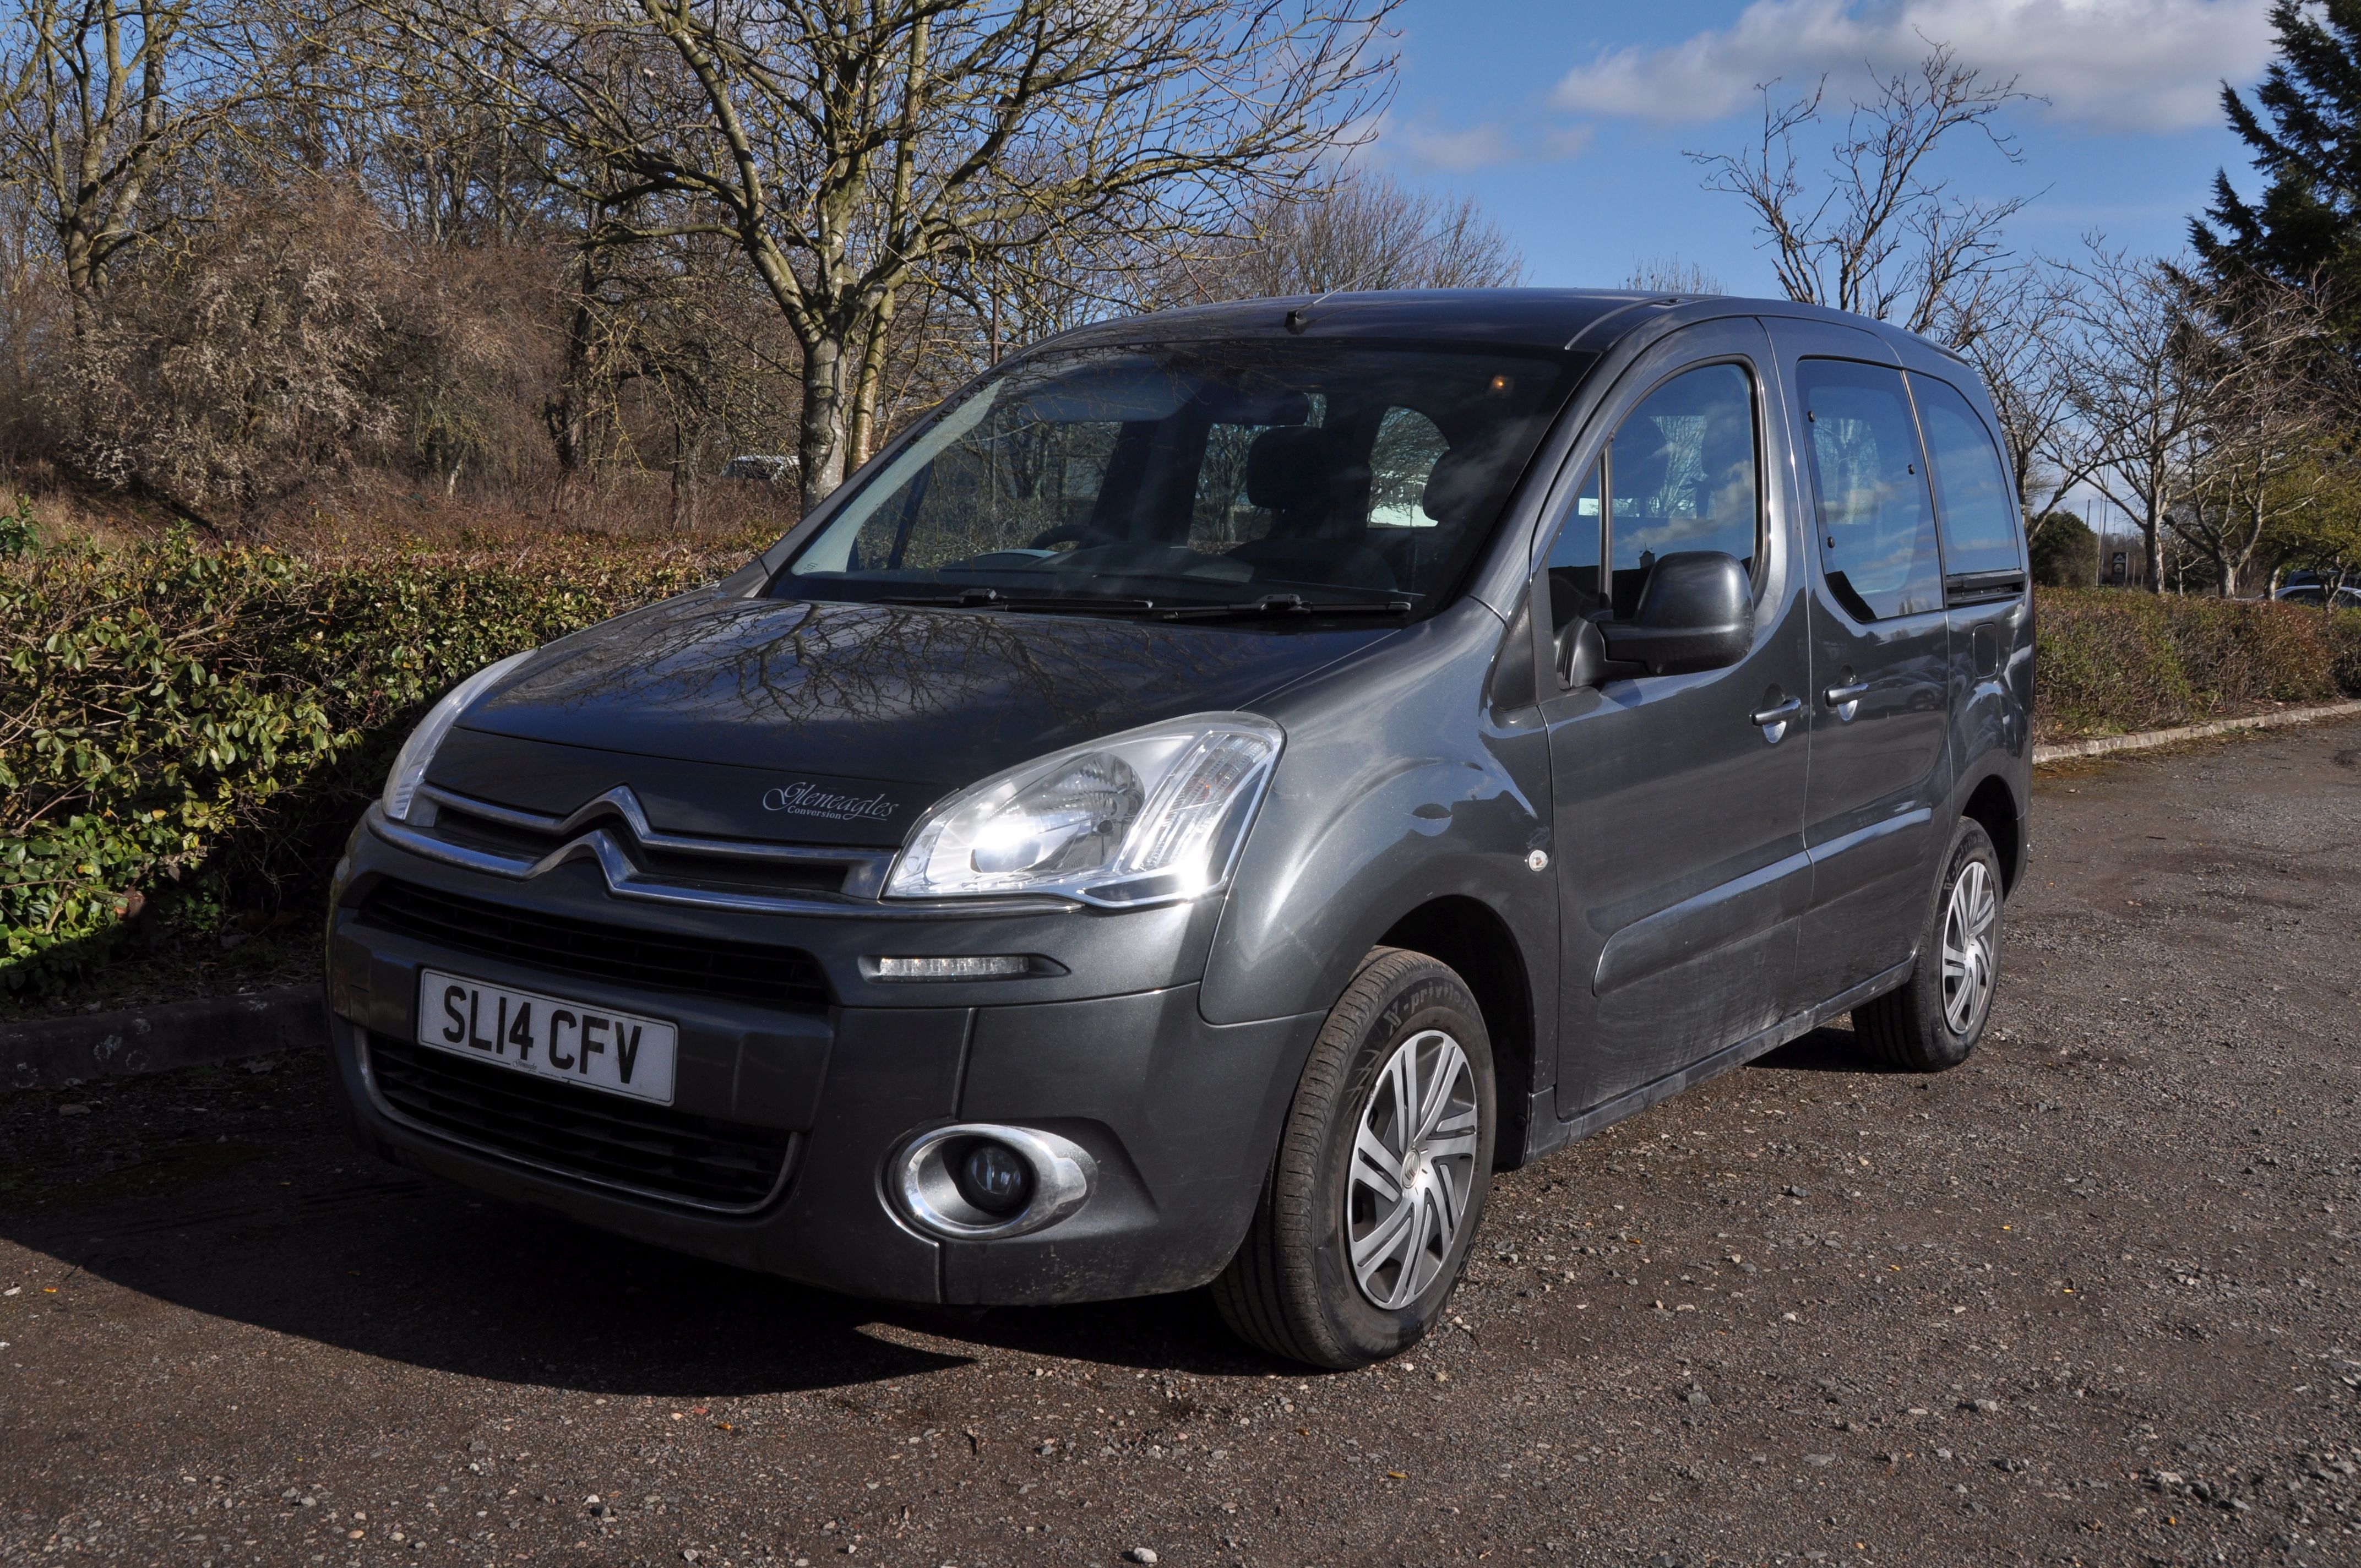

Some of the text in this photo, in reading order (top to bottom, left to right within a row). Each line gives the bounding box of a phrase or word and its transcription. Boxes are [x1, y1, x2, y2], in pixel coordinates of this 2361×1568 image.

[763, 782, 899, 820] Gleneagles
[787, 805, 842, 819] Conversion
[443, 985, 642, 1084] SL14 CFV
